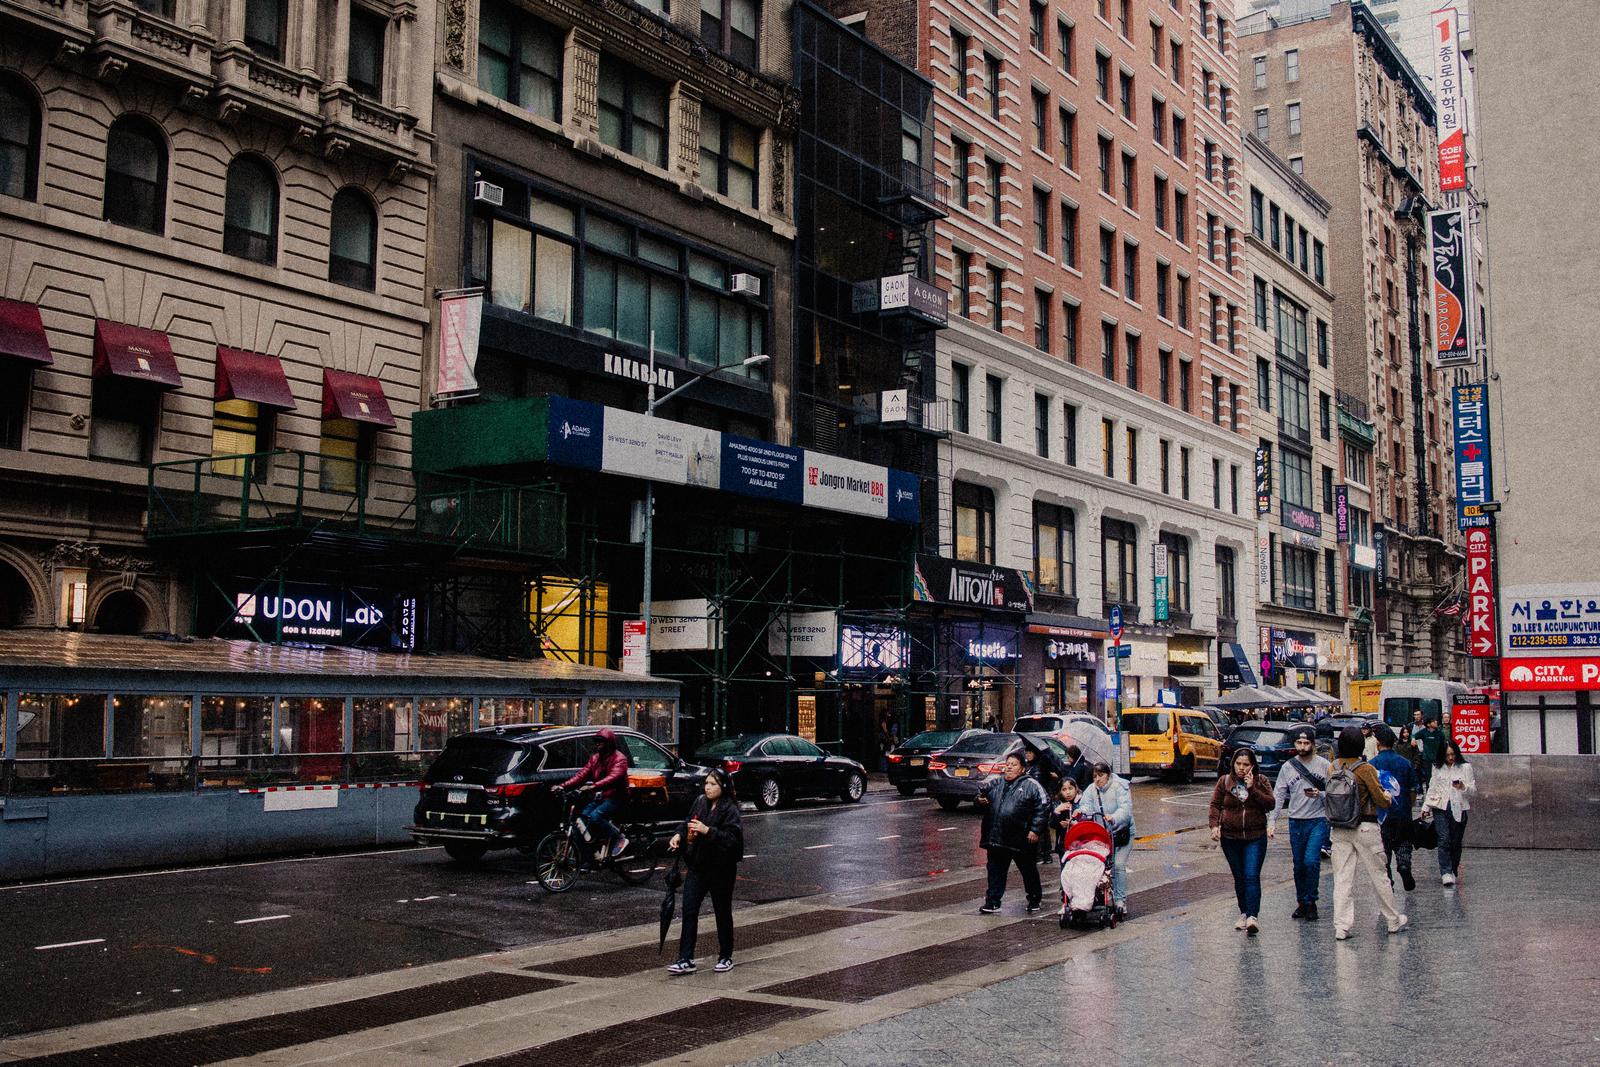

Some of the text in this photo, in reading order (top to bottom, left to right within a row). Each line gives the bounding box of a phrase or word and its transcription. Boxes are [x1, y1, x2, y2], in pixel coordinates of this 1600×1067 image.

[1439, 46, 1457, 130] 종로유학원
[1440, 146, 1462, 156] COEI
[1442, 176, 1452, 186] 15
[885, 280, 906, 292] GAON
[883, 292, 906, 305] CLINIC
[922, 288, 943, 306] GAON
[1438, 292, 1450, 346] KARAOKE
[884, 406, 907, 414] GAON
[1458, 401, 1484, 444] 닥터스
[614, 436, 628, 444] WEST
[629, 438, 641, 447] 32ND
[657, 433, 670, 441] DAVID
[728, 442, 748, 451] AMAZING
[772, 450, 784, 458] FLOOR
[784, 453, 798, 462] SPACE
[737, 453, 748, 461] PLUS
[748, 456, 766, 464] VARIOUS
[778, 461, 790, 469] FROM
[741, 466, 752, 475] 700
[752, 468, 758, 476] SF
[758, 470, 766, 478] TO
[766, 471, 778, 479] 4700
[1256, 450, 1264, 493] SPA
[749, 478, 778, 489] AVAILABLE
[820, 471, 844, 490] Jongro
[846, 476, 870, 494] Market
[871, 480, 884, 498] BBQ
[1338, 494, 1348, 532] CHORUS
[1467, 506, 1476, 515] 10
[1260, 548, 1268, 585] NewBank
[948, 567, 994, 606] ANTOYA
[1471, 557, 1491, 632] PARK
[262, 595, 332, 622] UDON
[402, 598, 410, 635] UDON
[658, 616, 678, 625] WEST
[678, 616, 699, 624] 32ND
[660, 626, 686, 634] STREET
[1512, 636, 1568, 646] 212-239-5559
[1274, 645, 1286, 661] SPA
[1534, 664, 1600, 684] CITY P
[1455, 734, 1480, 752] 29
